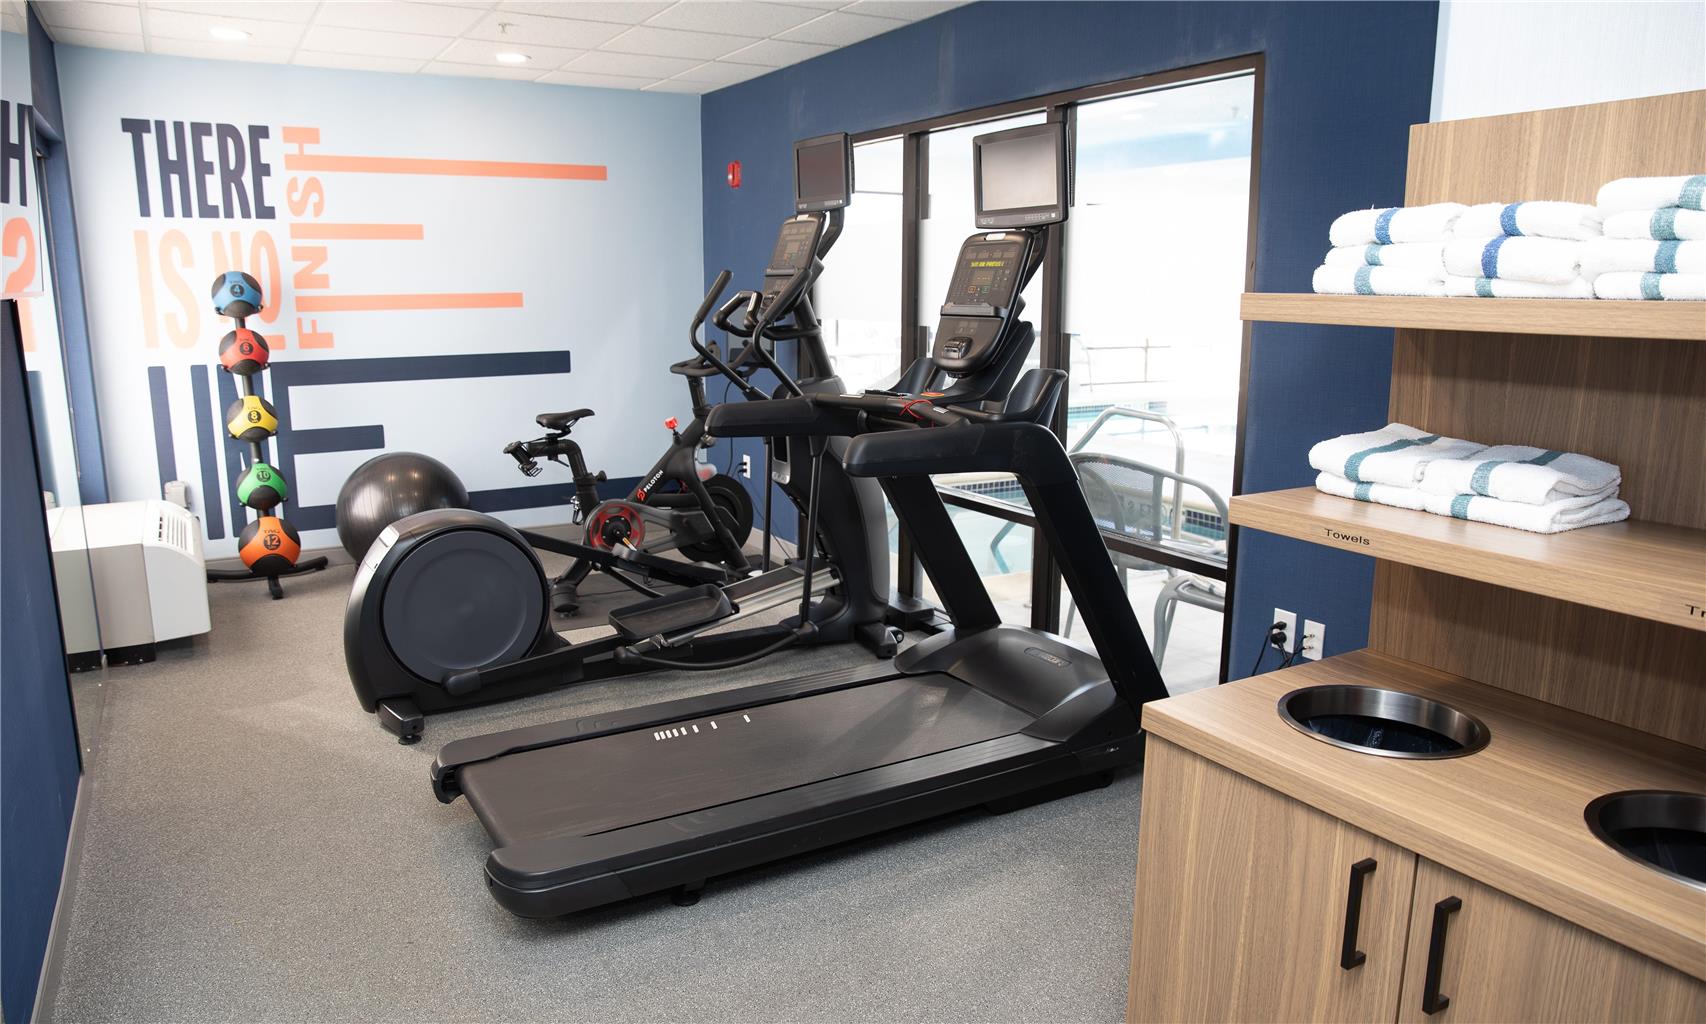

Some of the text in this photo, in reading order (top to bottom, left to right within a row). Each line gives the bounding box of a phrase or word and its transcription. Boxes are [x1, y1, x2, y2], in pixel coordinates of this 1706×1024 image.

[121, 118, 276, 219] THERE
[133, 229, 201, 349] IS
[211, 230, 282, 324] NO
[643, 469, 664, 493] PELOTON
[1324, 528, 1370, 545] Towels
